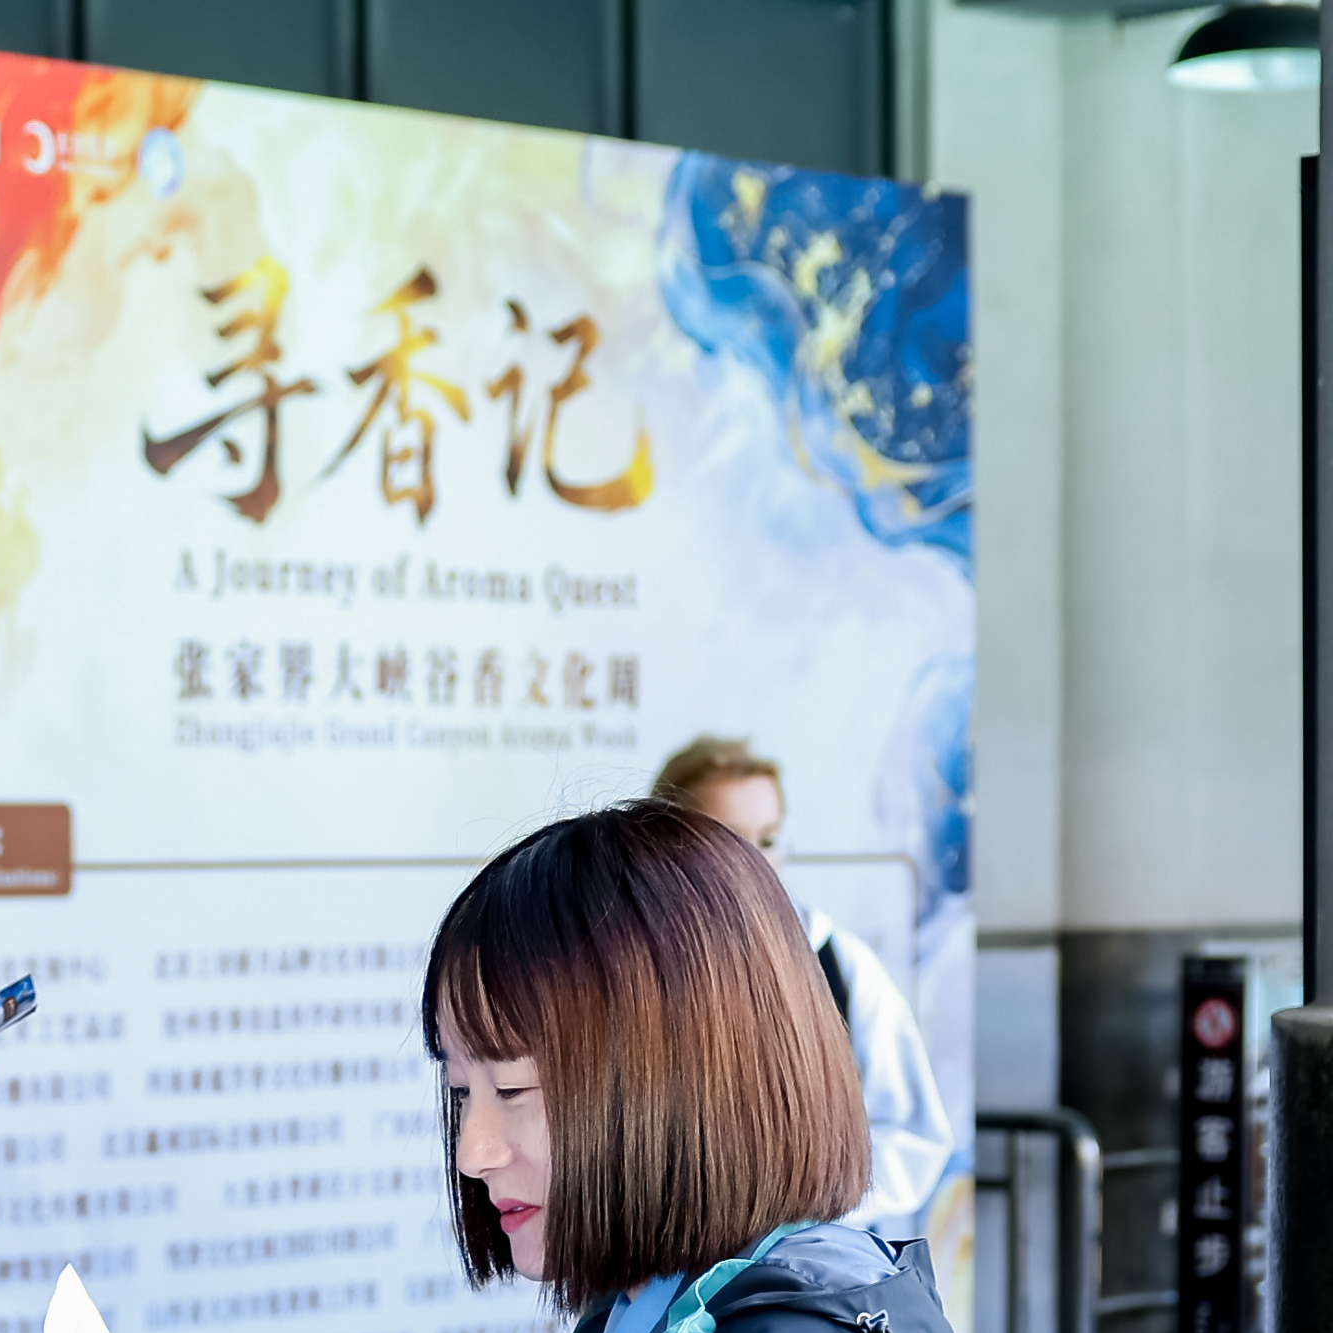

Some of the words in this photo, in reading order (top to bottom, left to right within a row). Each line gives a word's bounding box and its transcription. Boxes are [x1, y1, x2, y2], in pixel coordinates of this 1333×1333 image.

[141, 255, 654, 527] 寻香记
[174, 549, 199, 591] A
[211, 549, 357, 609] Journey
[372, 552, 410, 598] of
[420, 558, 532, 604] Aroma
[544, 563, 638, 614] Quest
